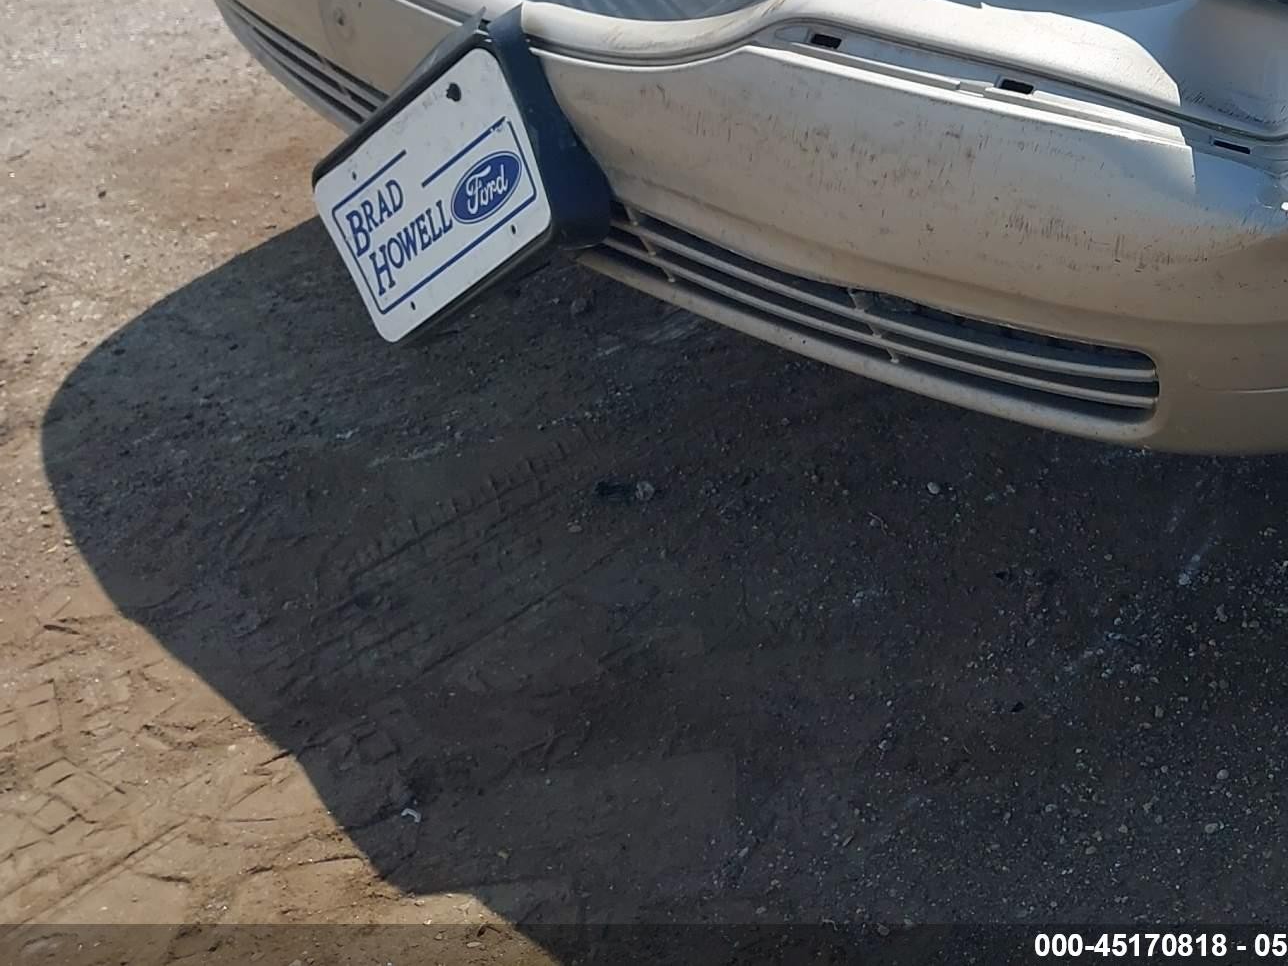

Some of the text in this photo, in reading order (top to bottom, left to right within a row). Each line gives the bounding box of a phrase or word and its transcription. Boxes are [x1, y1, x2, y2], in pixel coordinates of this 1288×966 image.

[346, 178, 405, 258] BRAD
[368, 164, 509, 297] HOWELL Ford
